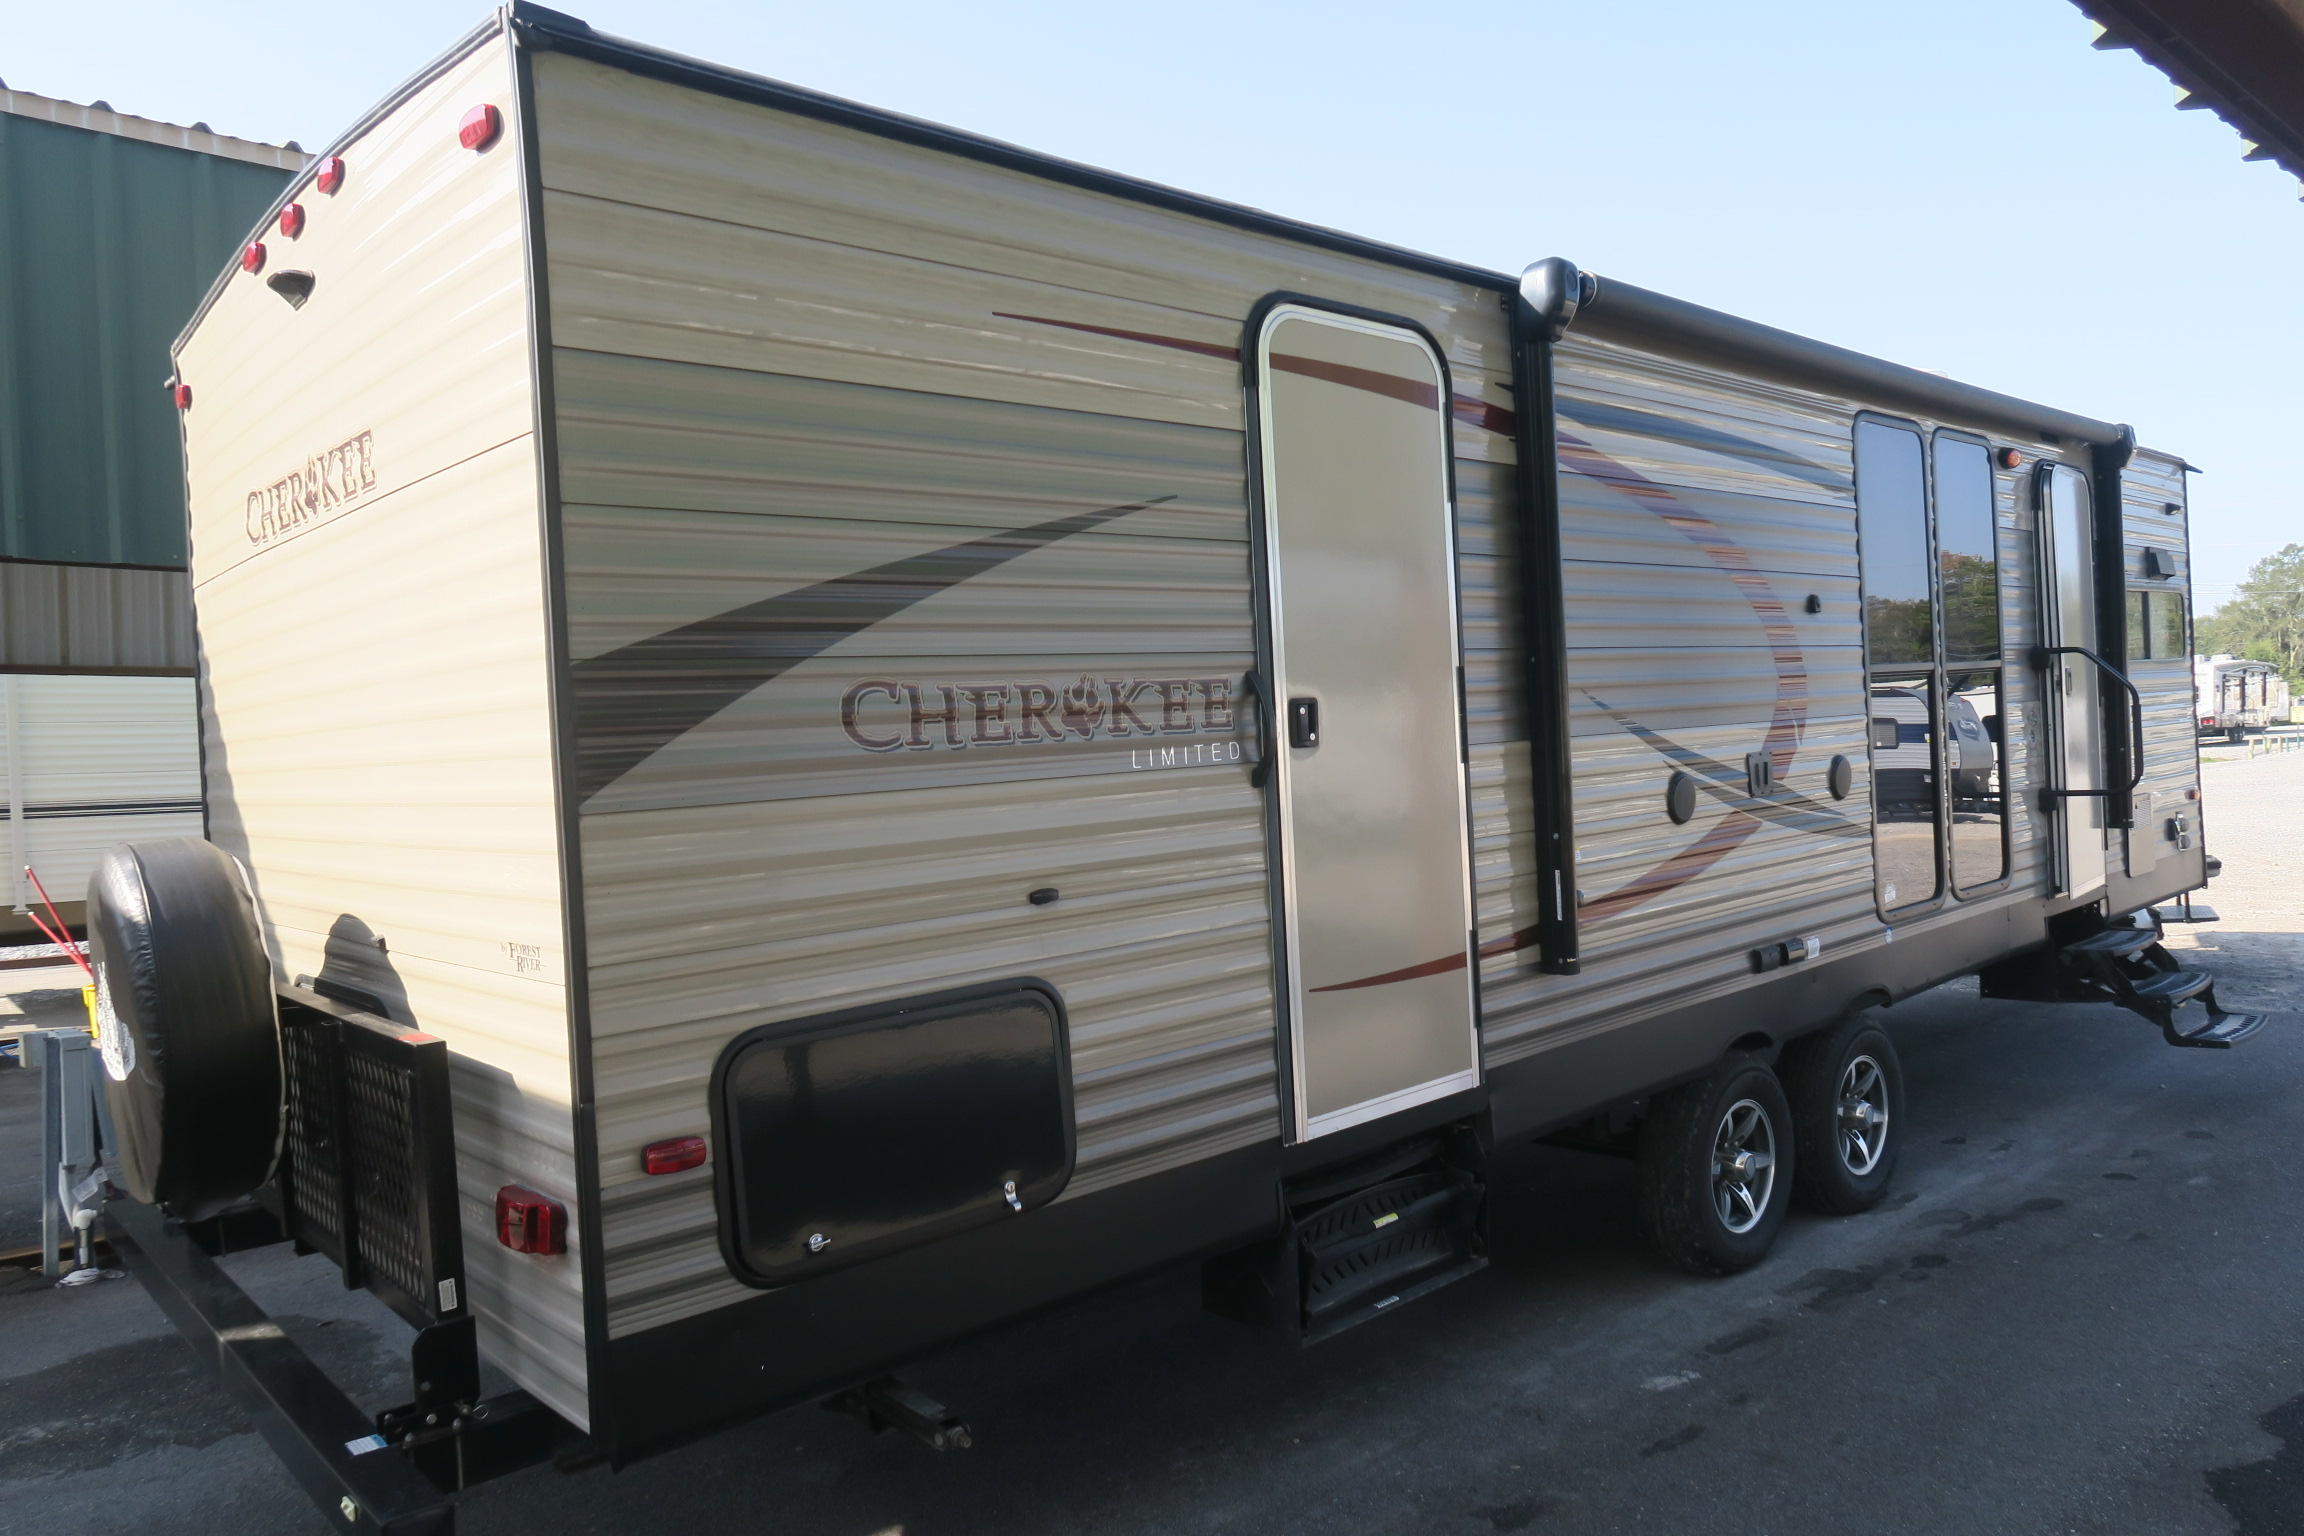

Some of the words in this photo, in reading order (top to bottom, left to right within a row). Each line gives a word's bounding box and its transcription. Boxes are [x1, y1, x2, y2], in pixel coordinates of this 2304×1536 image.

[246, 426, 377, 546] CHEROKEE
[839, 671, 1236, 753] CHEROKEE
[1131, 741, 1241, 769] LIMITED
[508, 941, 541, 959] FOREST
[516, 955, 541, 973] RIVER
